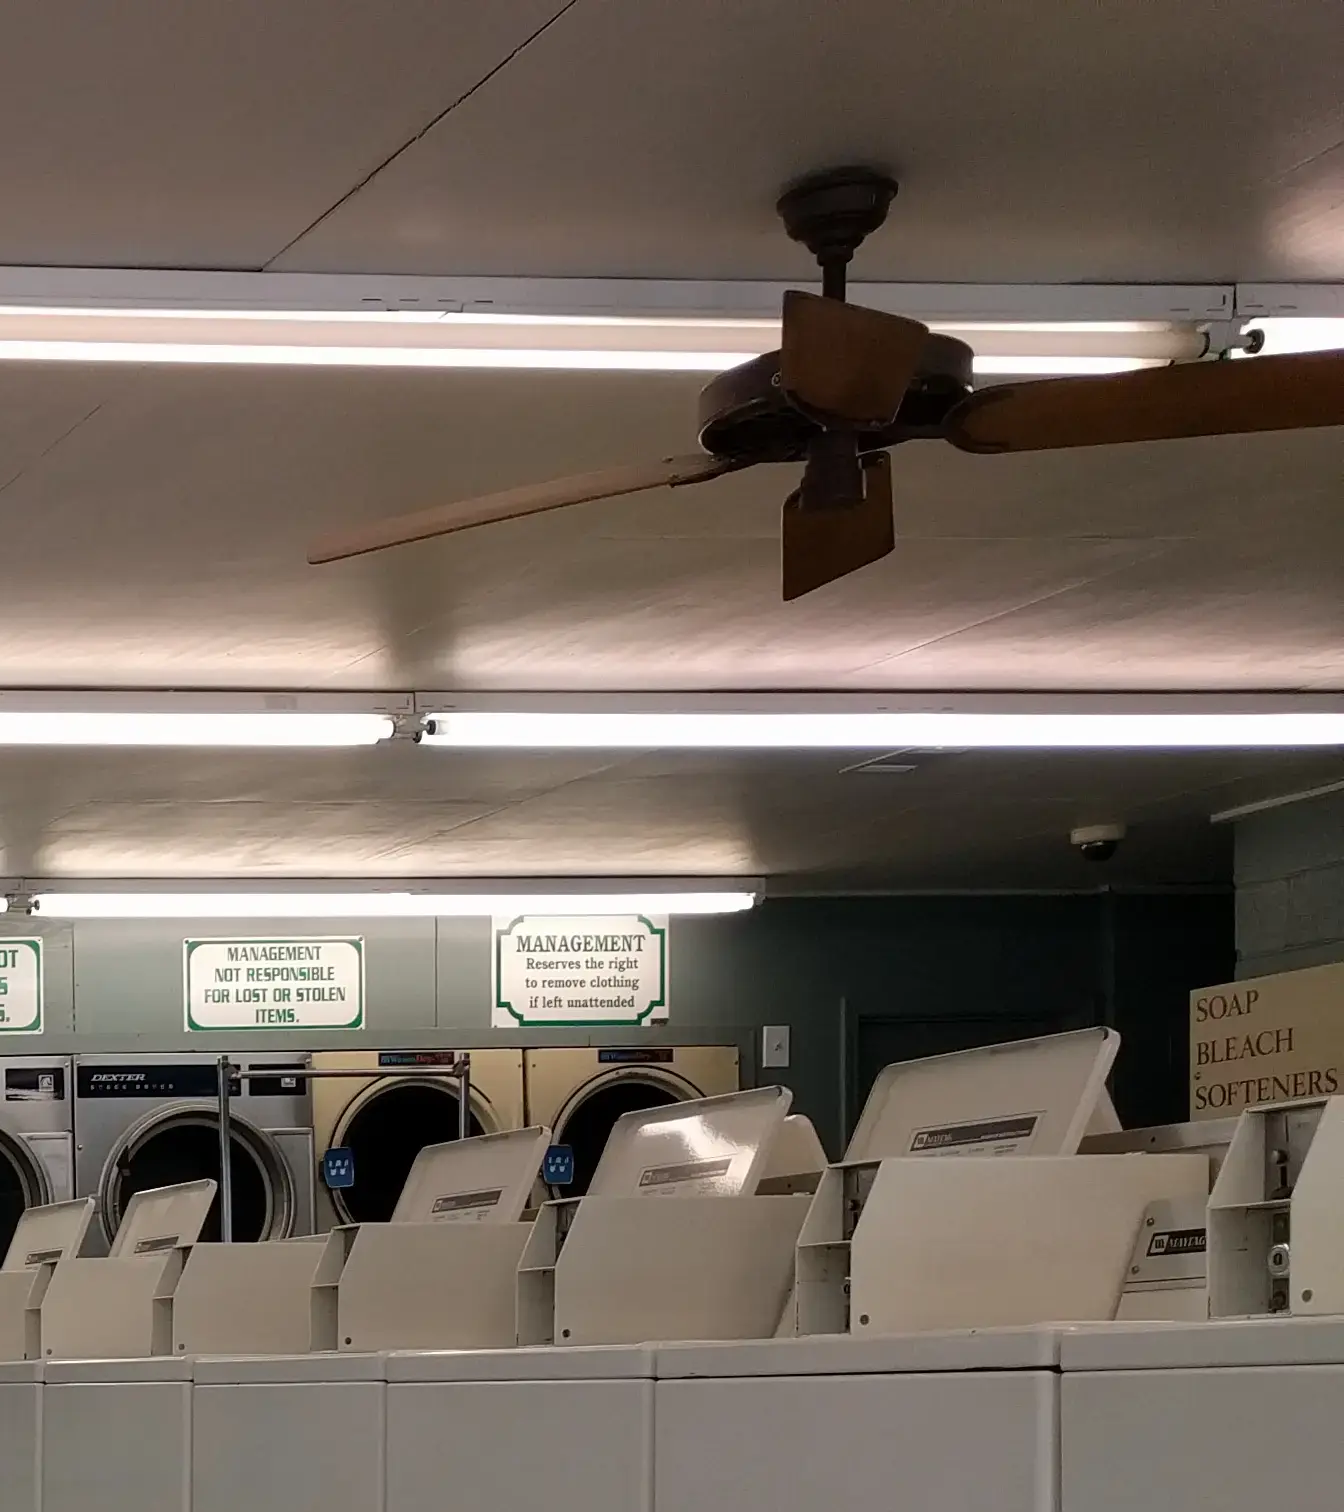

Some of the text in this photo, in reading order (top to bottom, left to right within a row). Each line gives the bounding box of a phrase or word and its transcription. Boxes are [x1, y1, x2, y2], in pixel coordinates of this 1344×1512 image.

[516, 935, 646, 953] MANAGEMENT
[227, 946, 322, 961] MANAGEMENT
[526, 957, 639, 972] Reserves the right
[214, 966, 335, 983] NOT RESPONSIBLE
[525, 976, 640, 990] to remove clothing
[204, 987, 346, 1003] FOR LOST OR STOLEN
[529, 995, 635, 1009] if left unattended
[1196, 989, 1260, 1023] SOAP
[255, 1008, 300, 1024] ITEMS.
[1196, 1027, 1295, 1066] BLEACH
[90, 1073, 146, 1082] DEXTER
[1195, 1067, 1339, 1111] SOFTENERS
